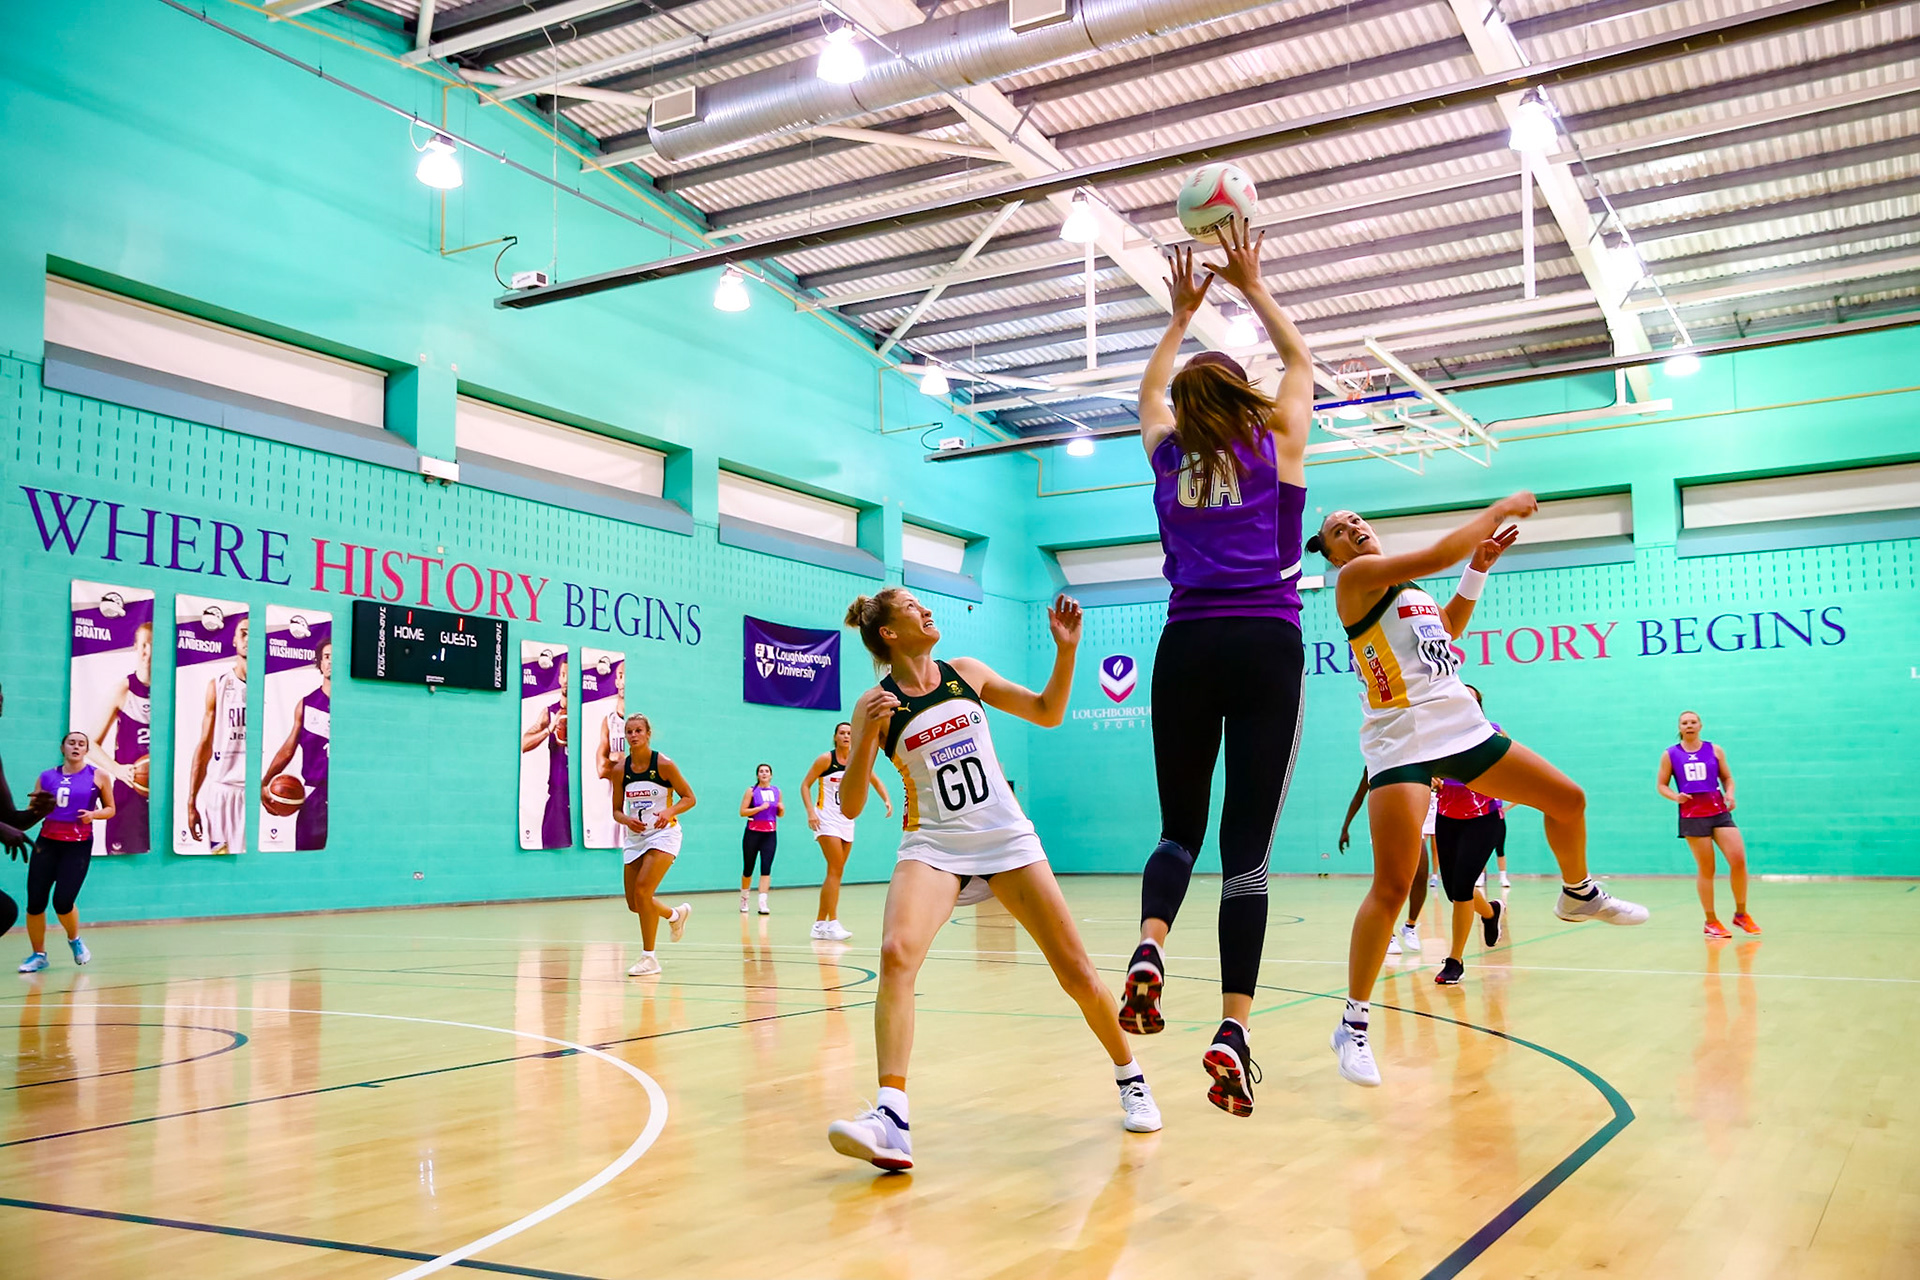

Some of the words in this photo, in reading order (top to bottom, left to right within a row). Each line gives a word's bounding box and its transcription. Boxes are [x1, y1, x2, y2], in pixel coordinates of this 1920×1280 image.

[1178, 450, 1243, 508] GA
[19, 485, 292, 586] WHERE
[310, 538, 549, 623] HISTORY
[563, 581, 702, 646] BEGINS
[74, 624, 112, 642] BRATKA
[393, 624, 425, 642] HOME
[440, 630, 478, 648] GUESTS
[1636, 606, 1846, 657] BEGINS
[177, 636, 223, 654] ANDERSON
[775, 646, 832, 668] Loughborough
[776, 662, 817, 682] University
[919, 716, 968, 743] SPAR
[1093, 720, 1146, 731] SPORT
[932, 742, 976, 764] Telkom
[1683, 762, 1708, 782] GD
[936, 756, 990, 812] GD
